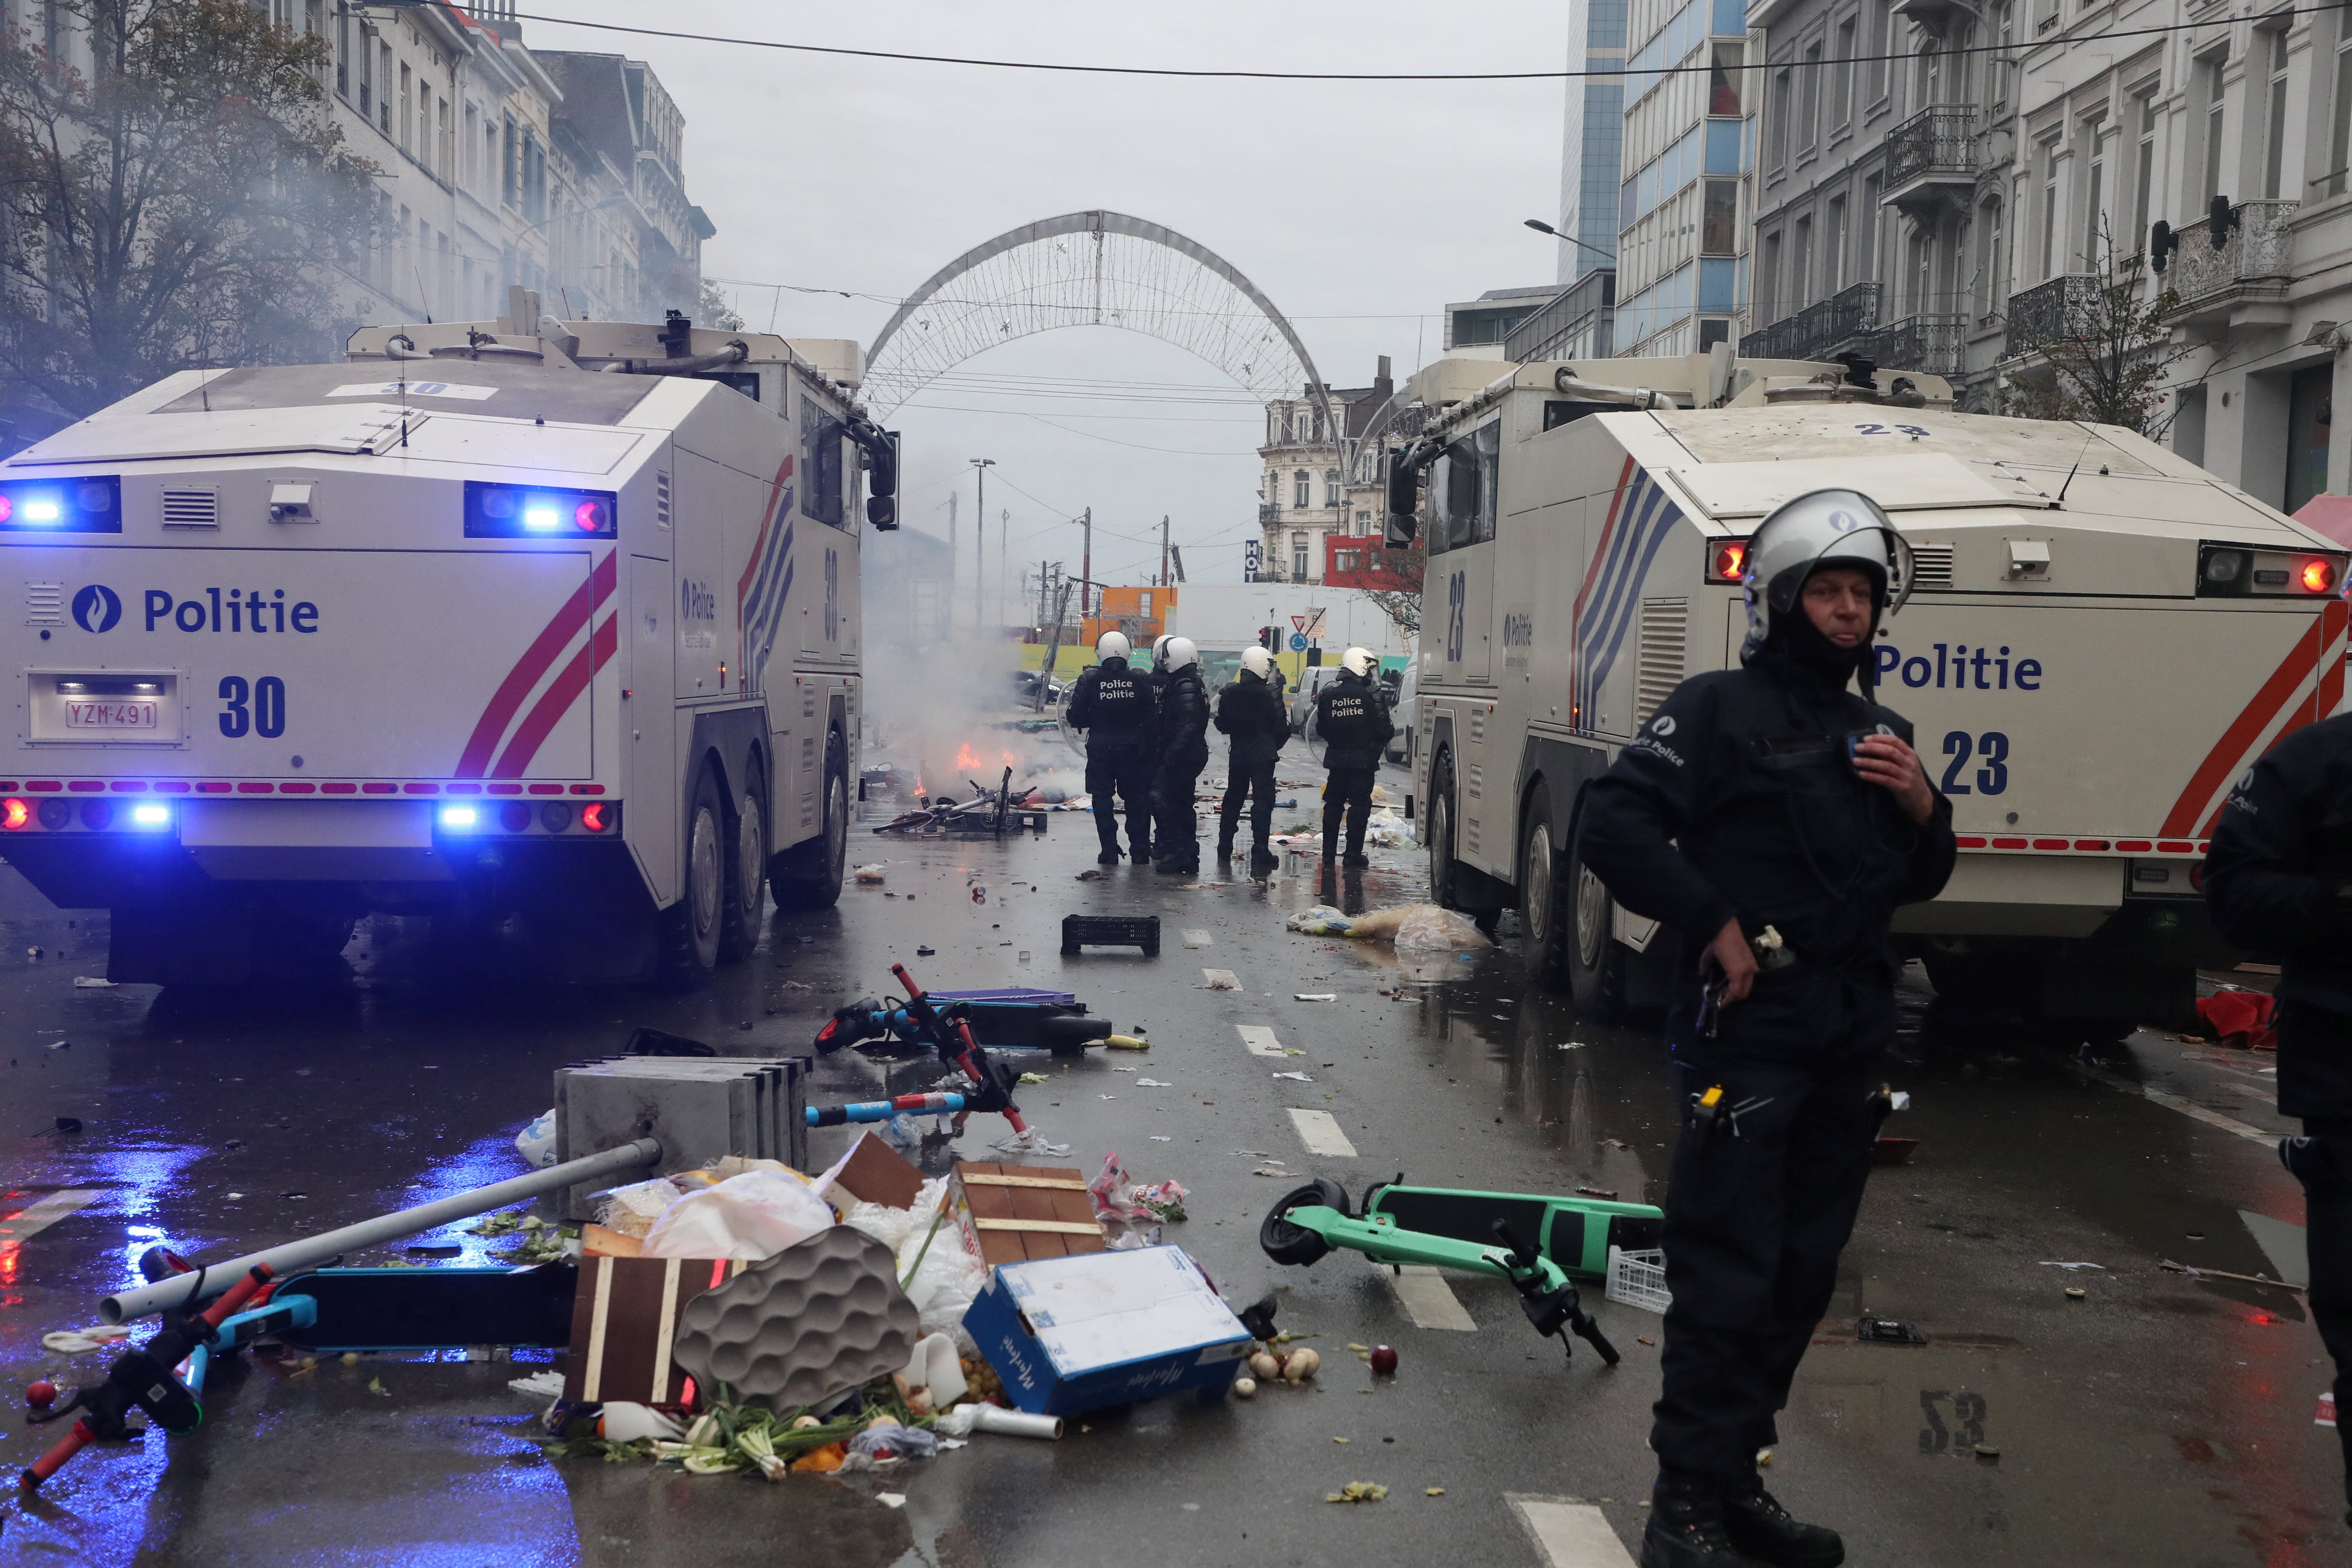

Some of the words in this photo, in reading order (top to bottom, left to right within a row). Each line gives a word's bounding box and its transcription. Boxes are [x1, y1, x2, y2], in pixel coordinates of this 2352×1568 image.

[380, 382, 448, 394] 30
[1854, 424, 1930, 435] 23
[145, 588, 318, 633] Politie
[692, 581, 714, 620] Police
[824, 547, 837, 642] 30
[1447, 570, 1465, 663] 23
[1512, 613, 1532, 646] Politie
[1874, 643, 2042, 690] Politie
[1099, 690, 1134, 700] Politie
[1100, 680, 1133, 689] Police
[218, 676, 285, 738] 30
[1332, 698, 1361, 707] Police
[1332, 707, 1363, 717] Politie
[1651, 741, 1684, 767] Police
[1942, 731, 2009, 796] 23
